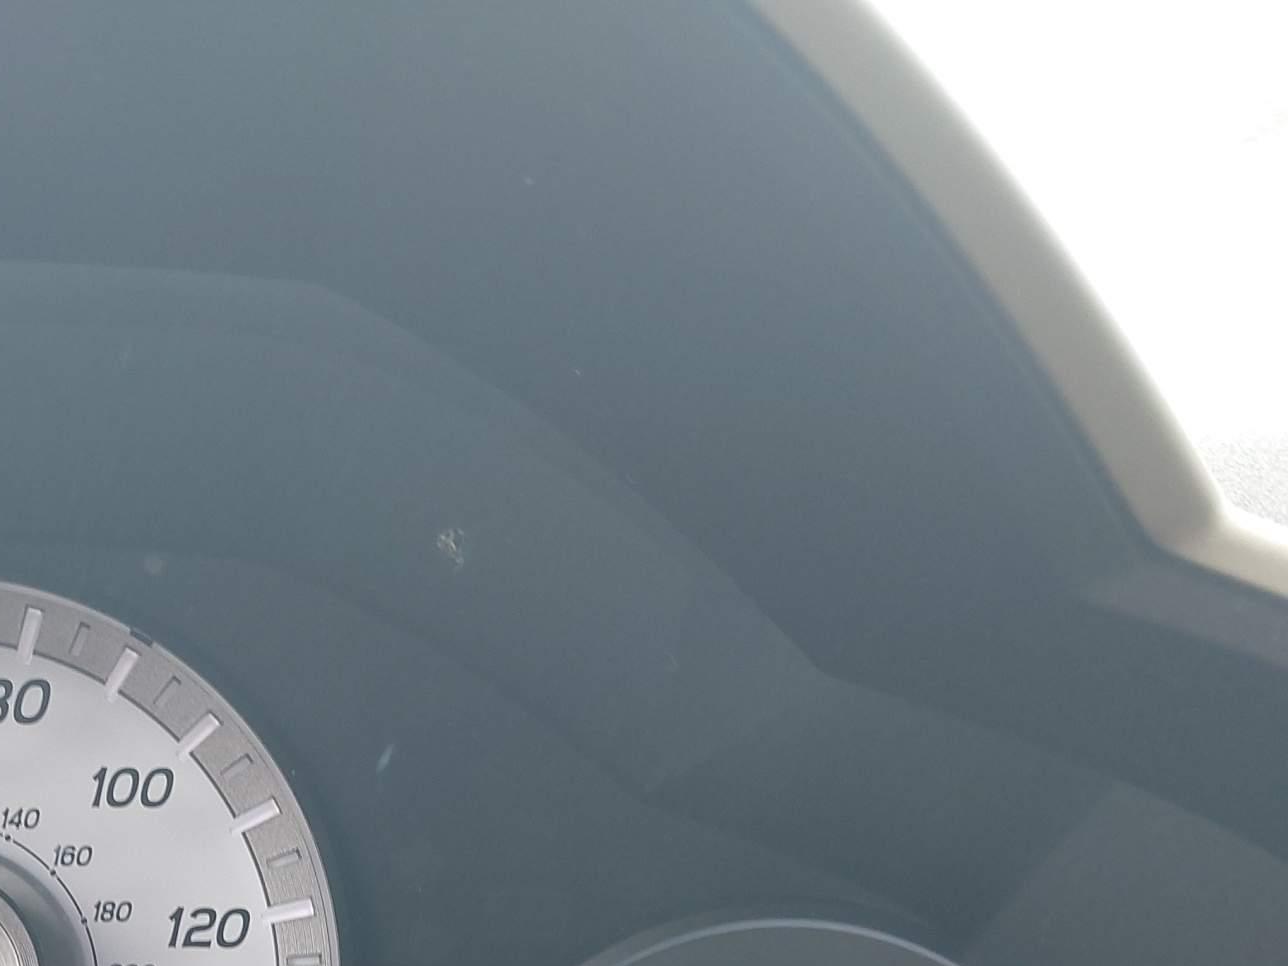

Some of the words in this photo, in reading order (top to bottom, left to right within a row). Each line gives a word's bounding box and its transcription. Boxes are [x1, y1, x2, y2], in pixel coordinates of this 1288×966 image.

[91, 767, 174, 809] 100
[1, 808, 40, 830] 140
[53, 845, 93, 867] 160
[93, 901, 132, 923] 180
[168, 907, 251, 949] 120
